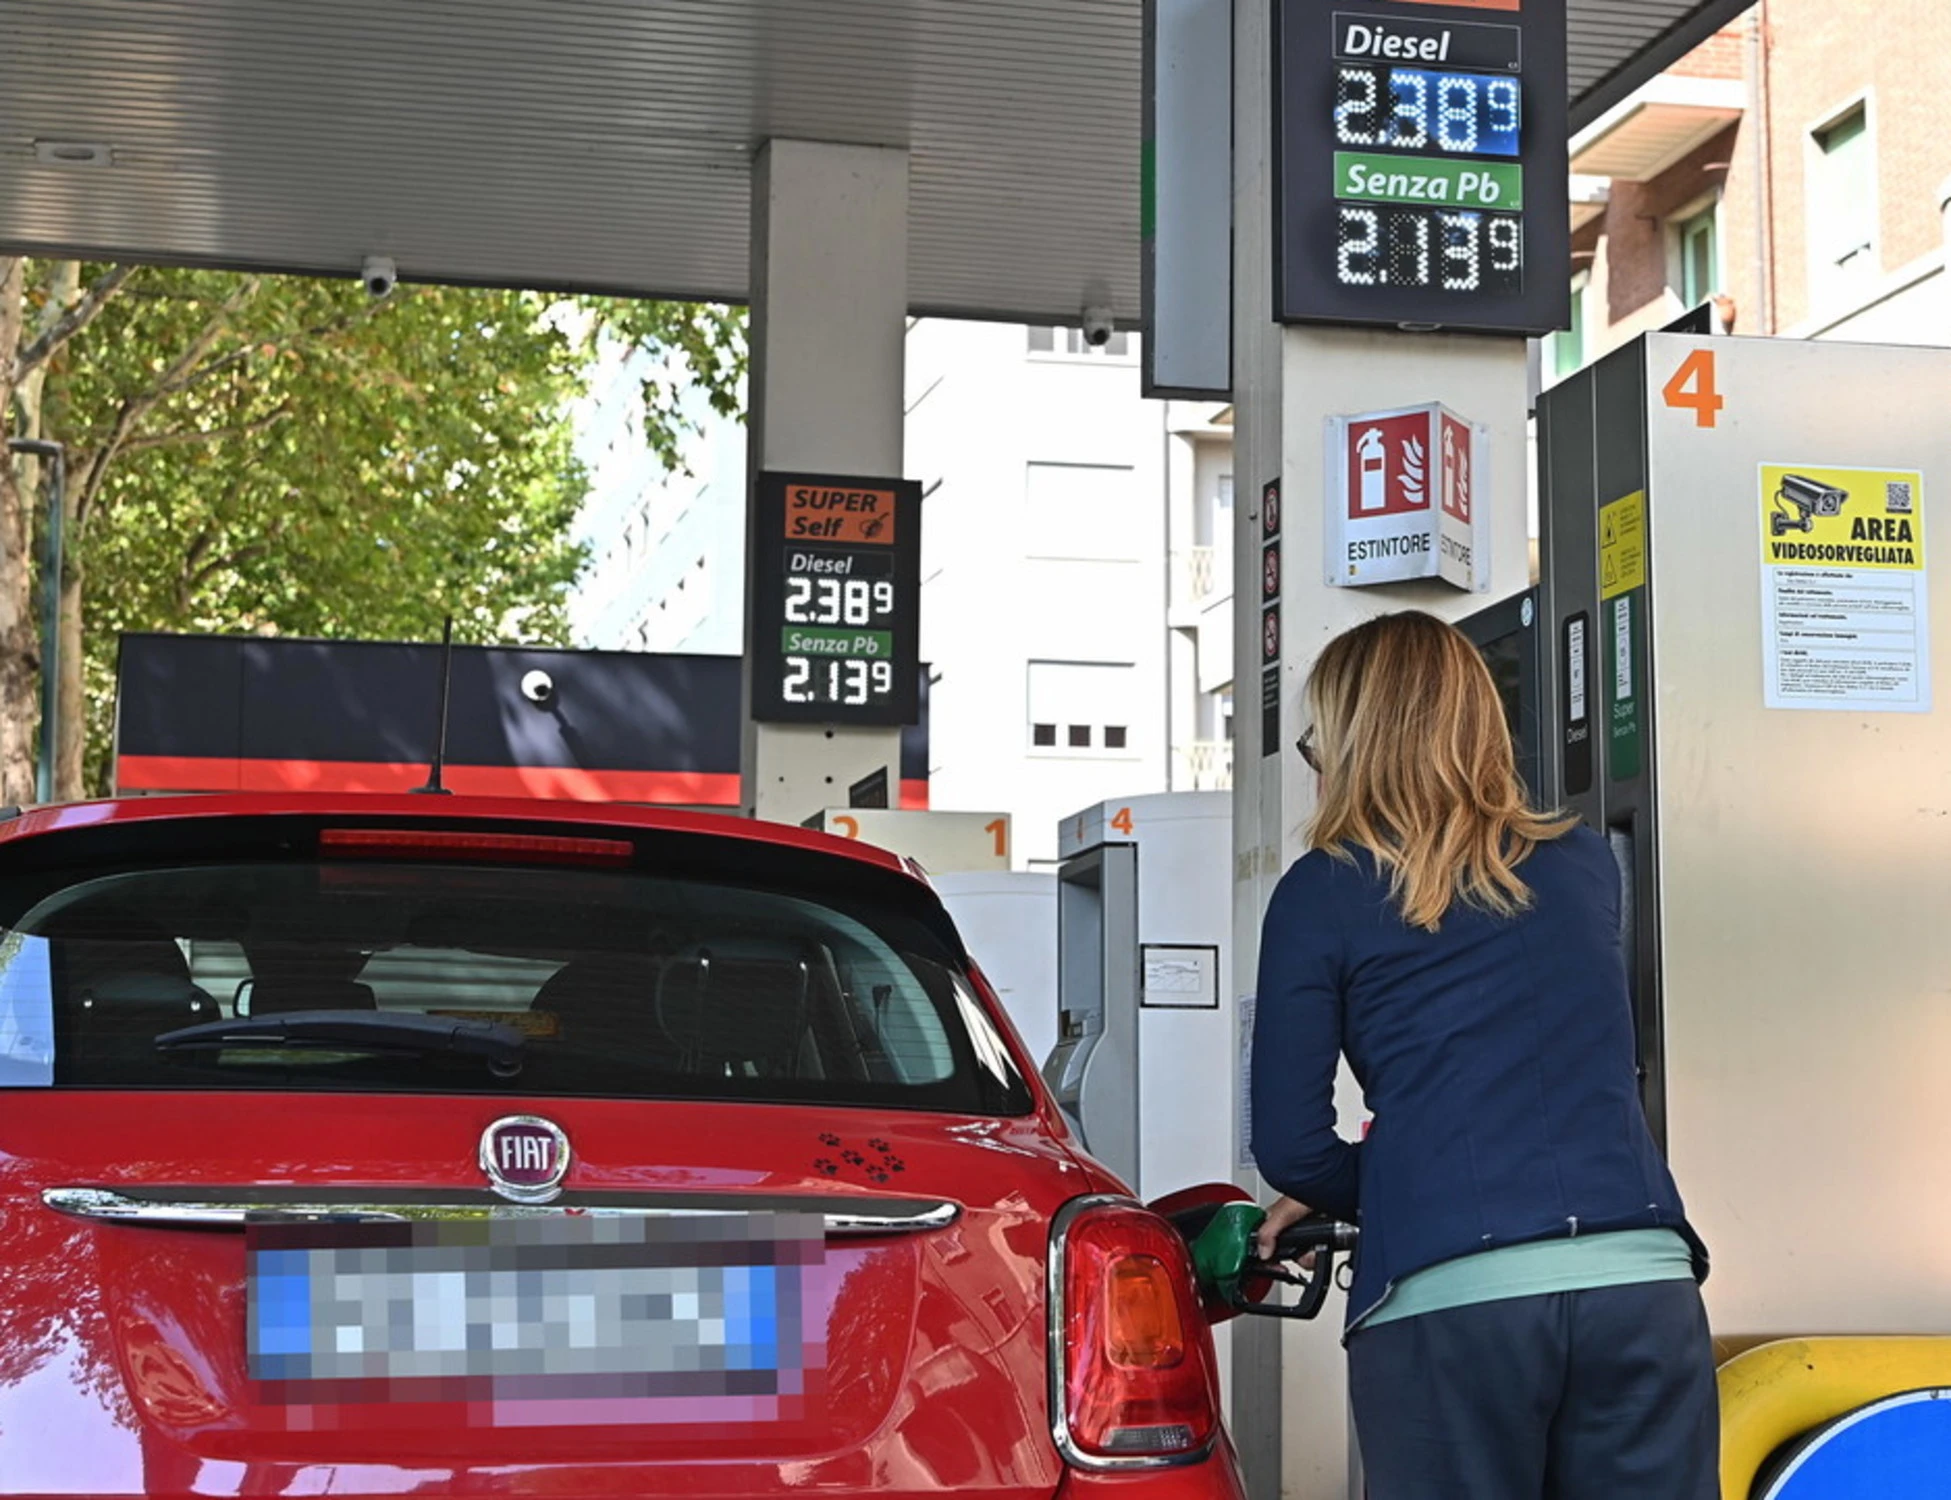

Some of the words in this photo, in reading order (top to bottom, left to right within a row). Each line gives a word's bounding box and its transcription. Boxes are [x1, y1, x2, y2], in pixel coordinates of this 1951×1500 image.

[1344, 24, 1450, 61] Diesel
[1336, 69, 1517, 152] 2.389
[1346, 164, 1449, 200] Senza
[1456, 171, 1500, 203] Pb
[1337, 208, 1519, 290] 2.139
[1662, 349, 1723, 428] 4
[793, 490, 878, 513] SUPER
[792, 516, 844, 537] Self
[1851, 517, 1914, 543] AREA
[790, 554, 852, 575] Diesel
[1348, 533, 1431, 561] ESTINTORE
[1771, 542, 1915, 565] VIDEOSORVEGLIATA
[785, 577, 893, 625] 2.389
[788, 633, 849, 653] Senza
[853, 636, 879, 655] Pb
[783, 656, 892, 705] 2.139
[984, 818, 1006, 857] 1
[1111, 807, 1133, 835] 4
[501, 1136, 552, 1171] FIAT
